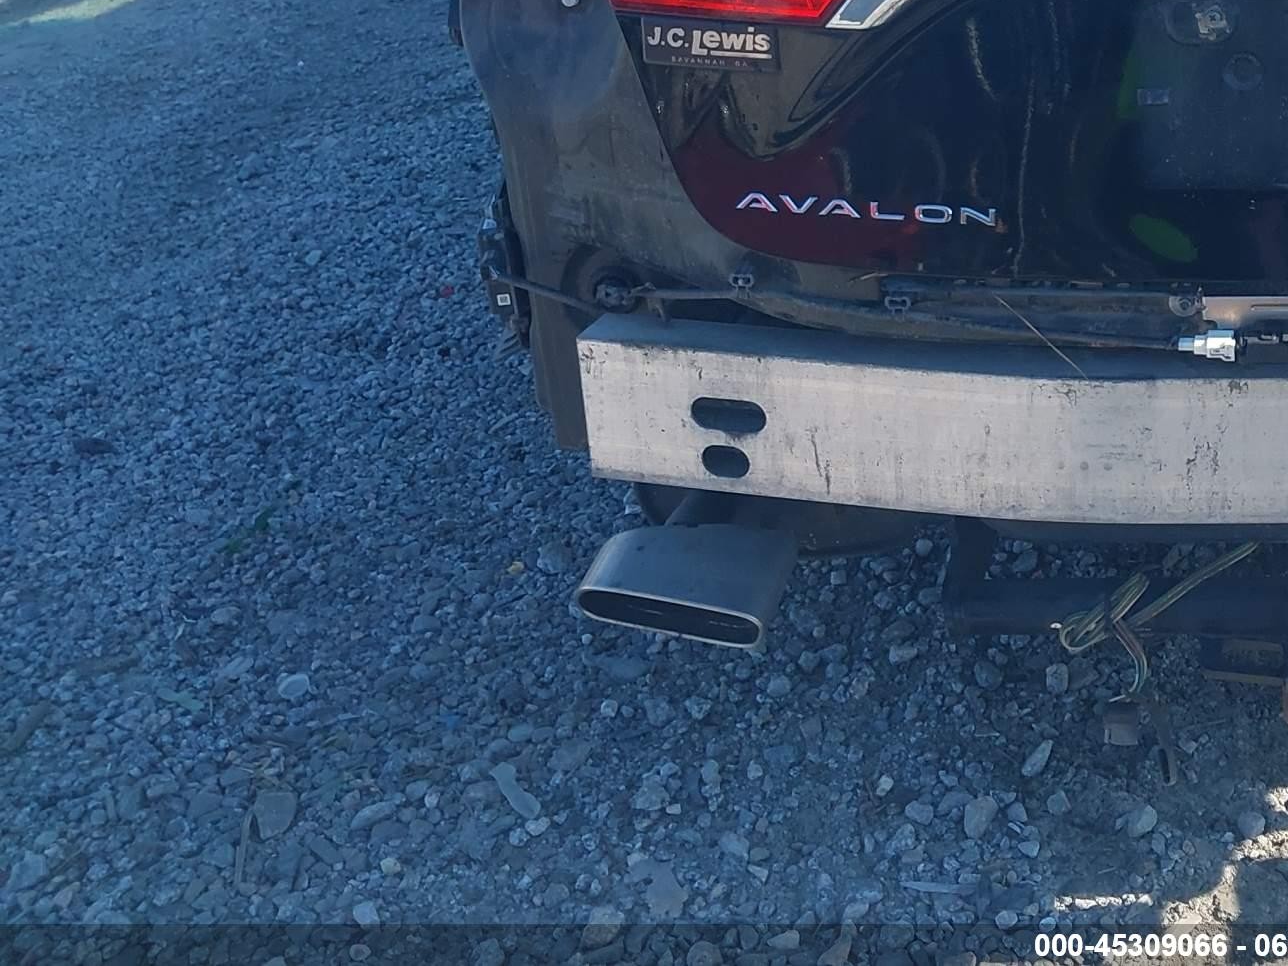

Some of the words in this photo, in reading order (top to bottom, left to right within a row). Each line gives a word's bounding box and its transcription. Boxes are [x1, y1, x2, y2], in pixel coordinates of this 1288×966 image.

[647, 26, 690, 48] J.C.
[691, 26, 771, 56] Lewis
[735, 192, 997, 227] AVALON
